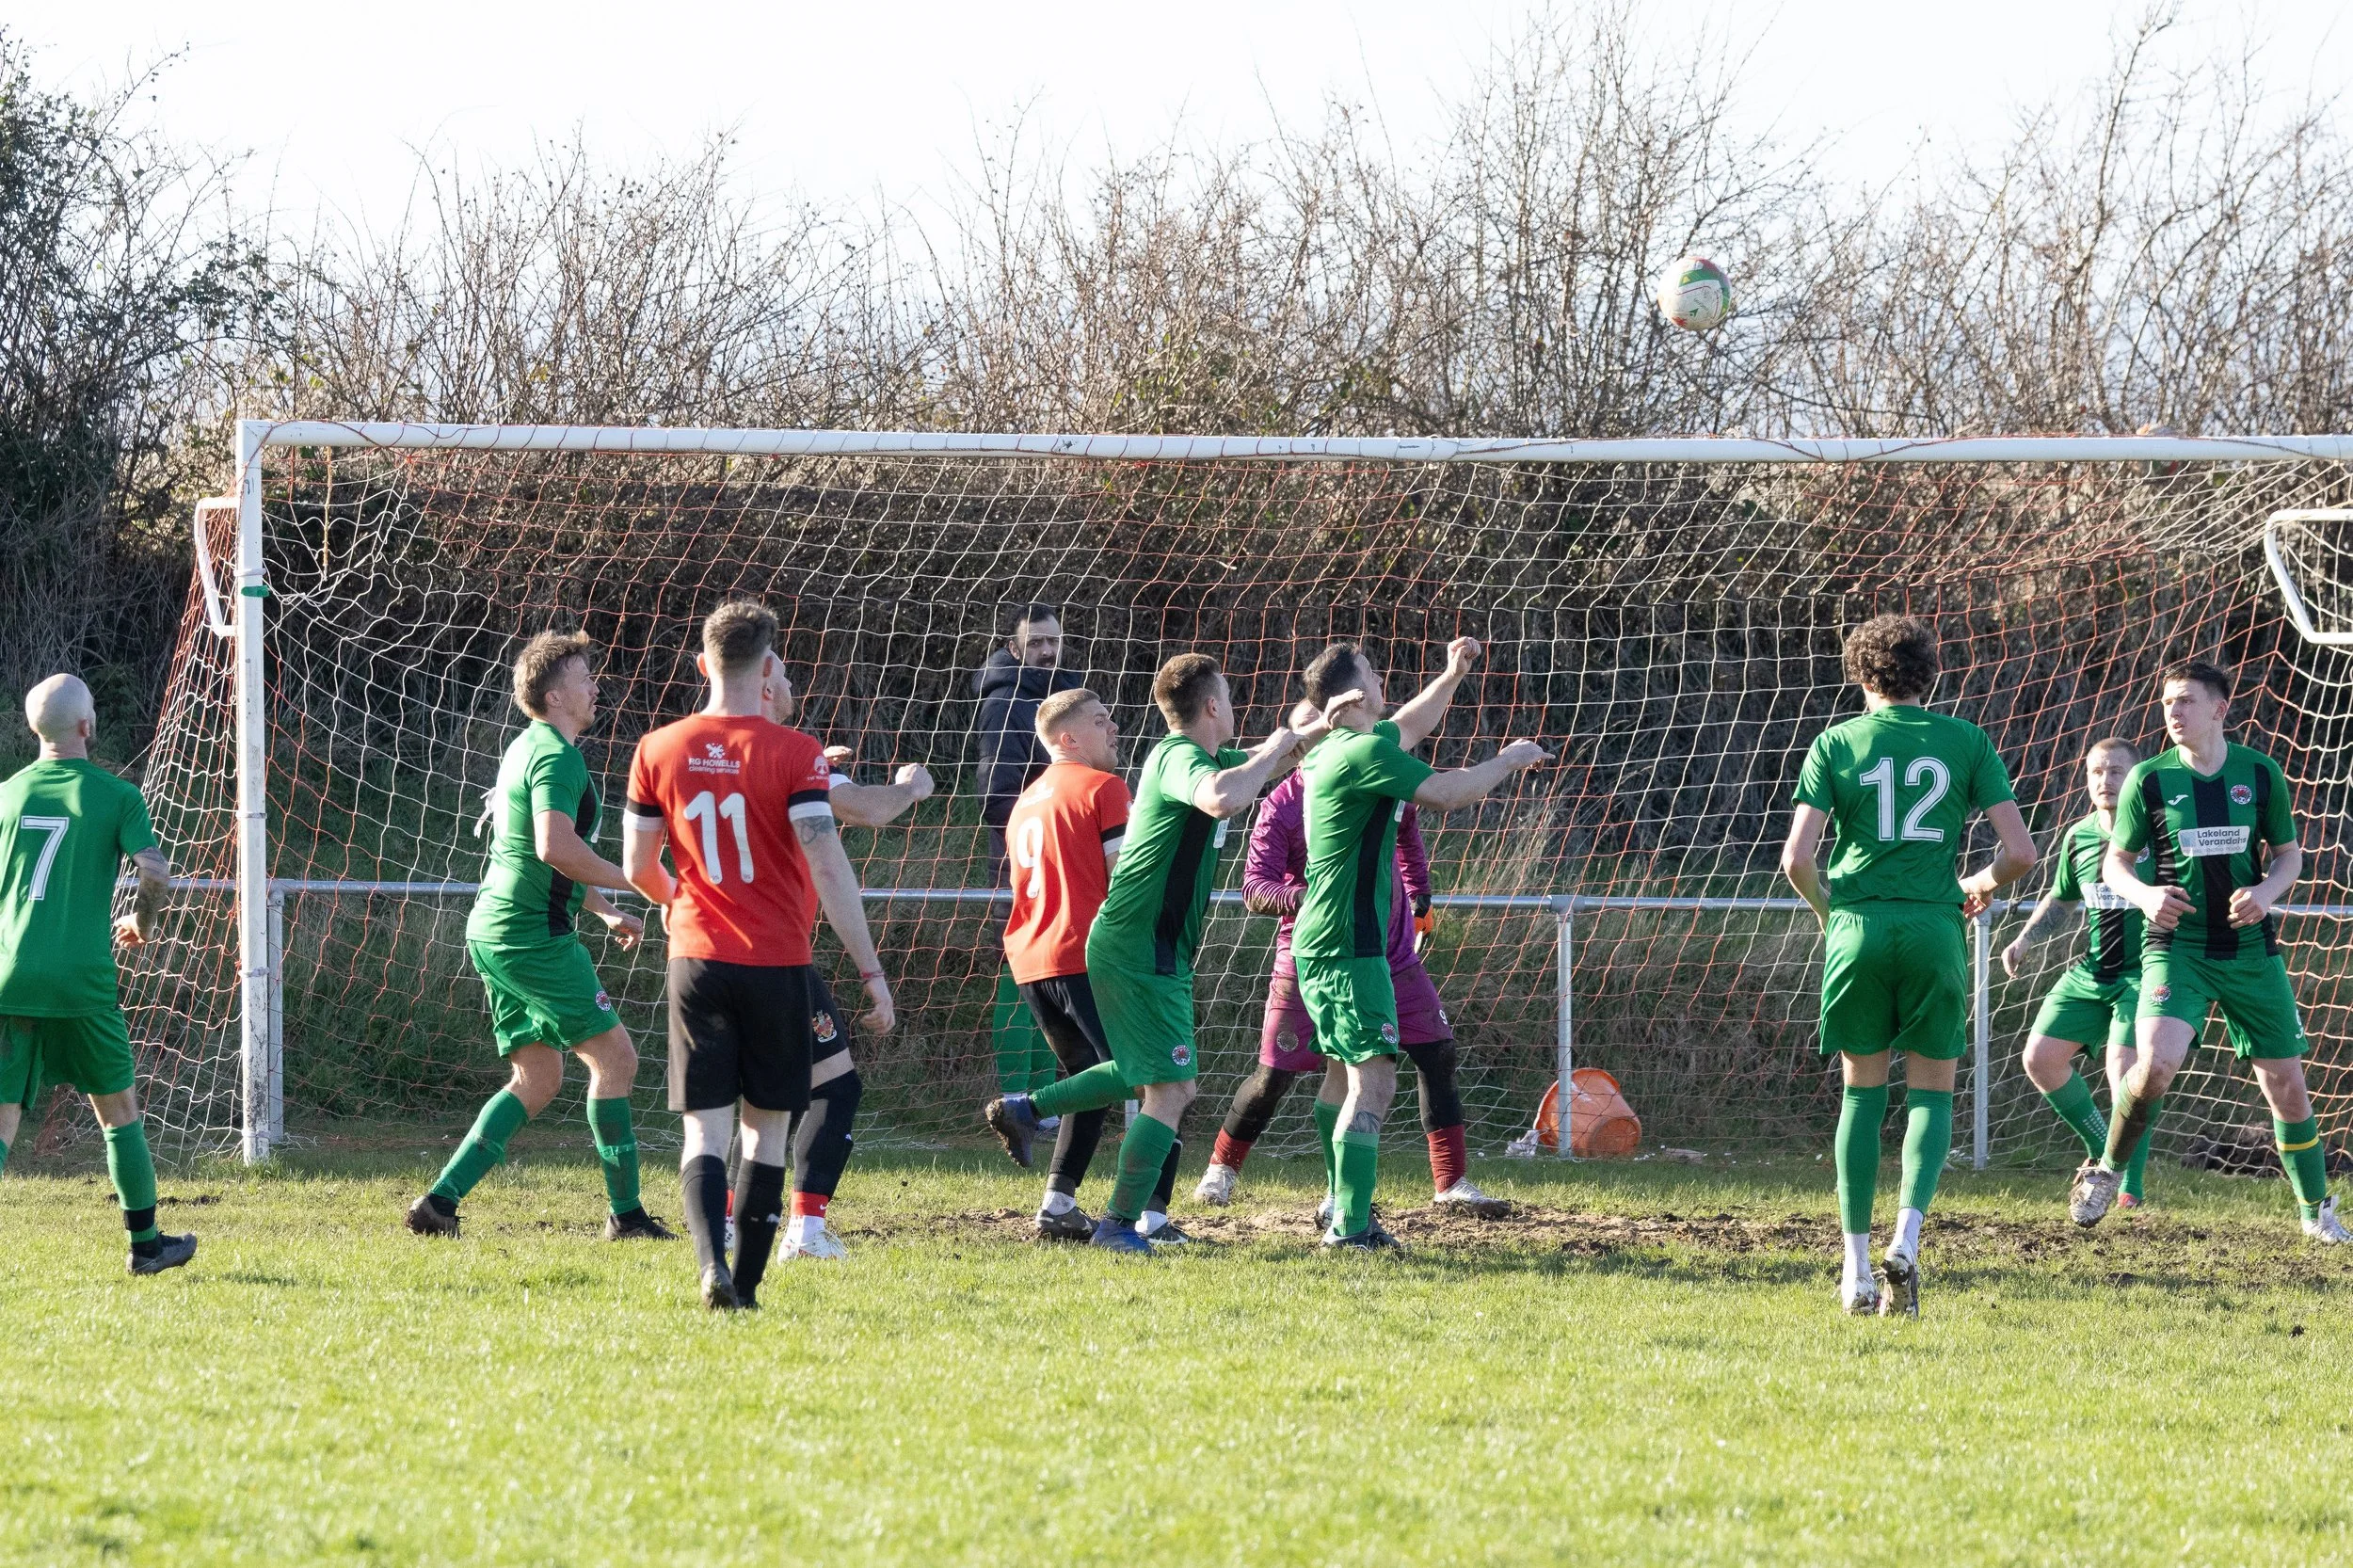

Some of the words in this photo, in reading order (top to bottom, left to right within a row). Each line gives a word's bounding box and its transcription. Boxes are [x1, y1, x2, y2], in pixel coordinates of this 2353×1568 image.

[688, 758, 701, 766] RG
[702, 759, 741, 768] HOWELLS
[688, 765, 715, 775] cleaning
[1859, 757, 1950, 842] 12
[683, 791, 754, 885] 11
[2197, 829, 2240, 839] Lakeland
[2198, 837, 2247, 846] Verandahs
[21, 815, 70, 900] 7
[1016, 816, 1044, 899] 9
[2095, 885, 2112, 893] Lake
[2096, 892, 2126, 901] Veran
[1439, 1009, 1448, 1025] 9
